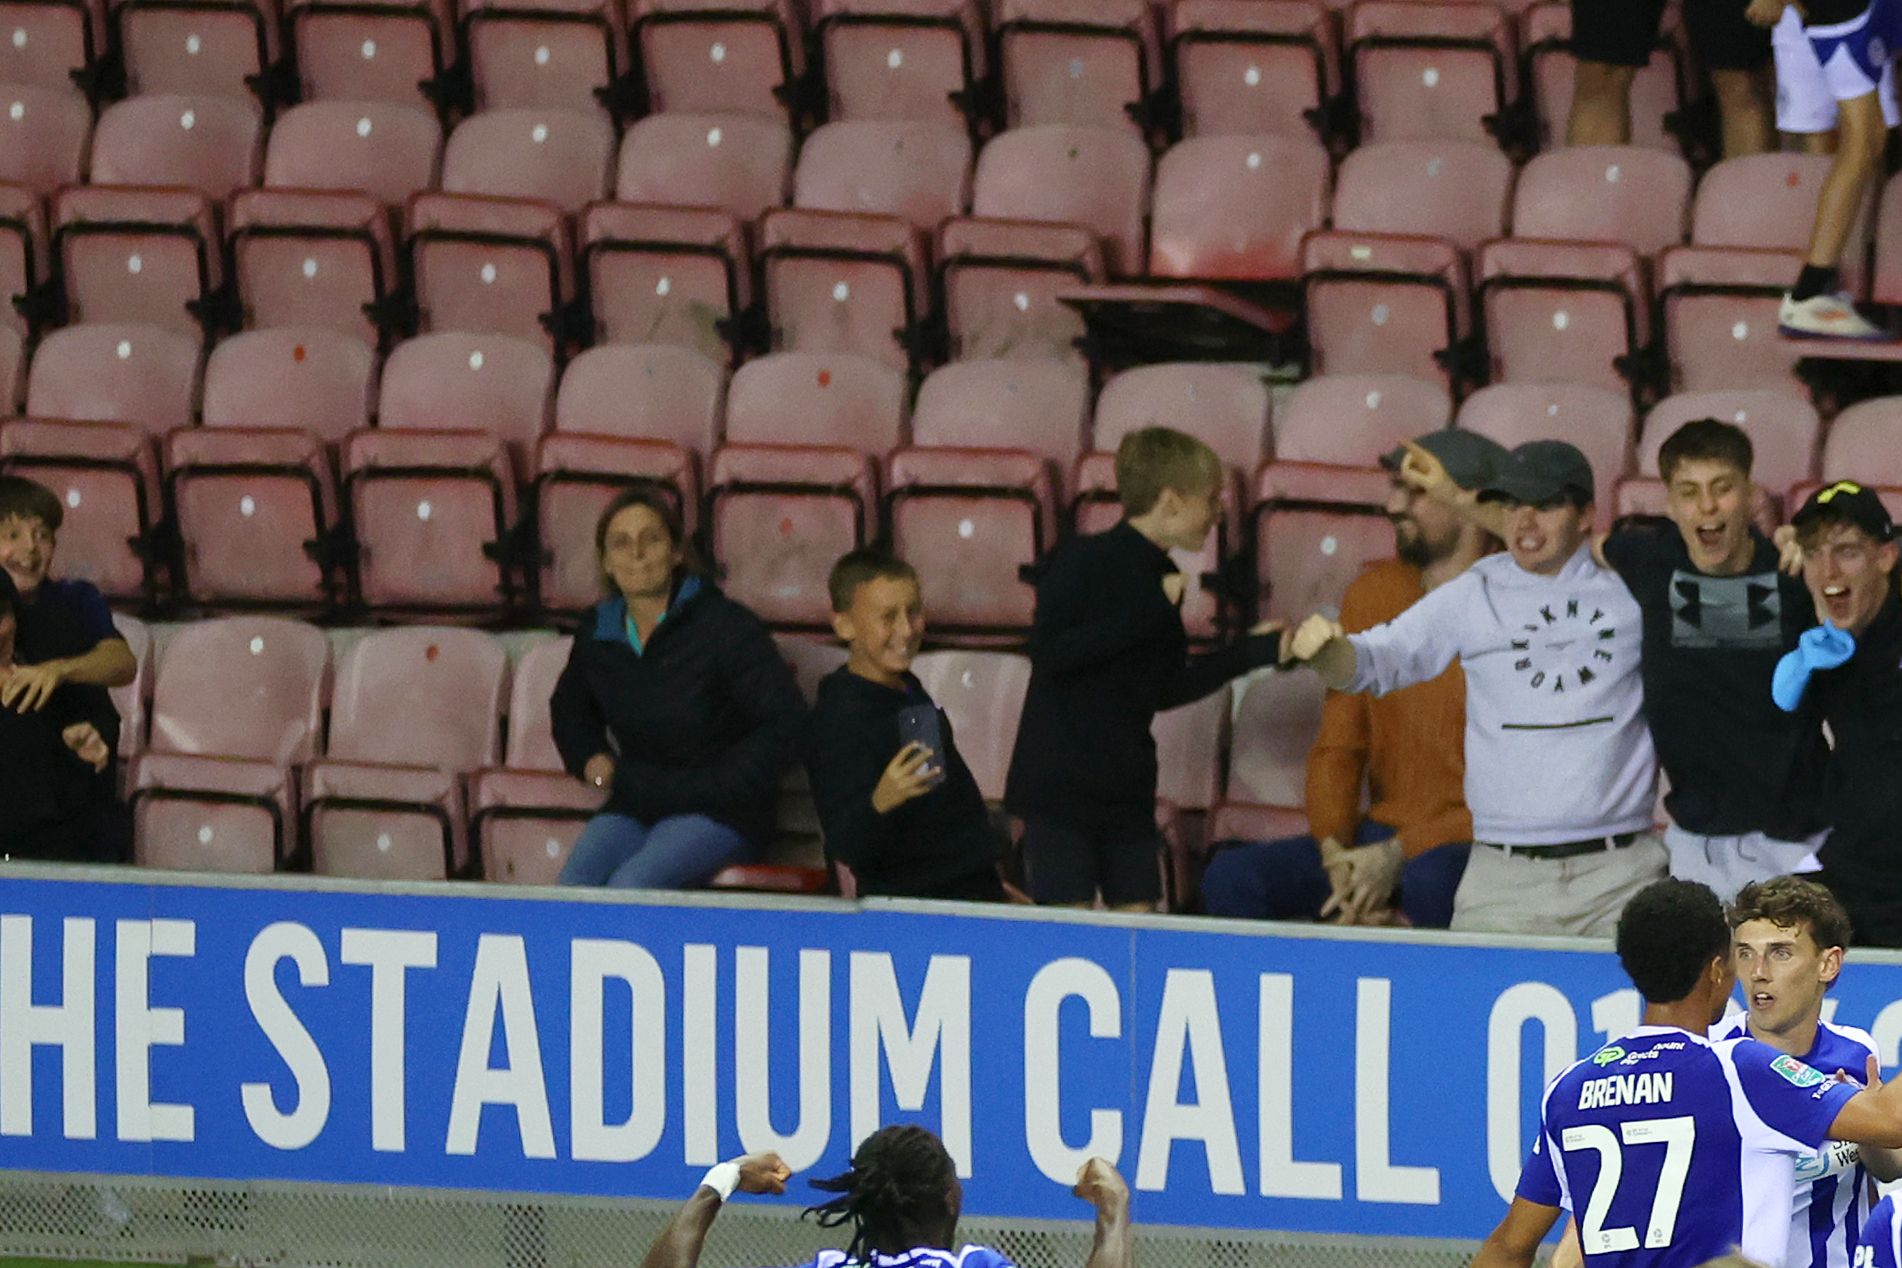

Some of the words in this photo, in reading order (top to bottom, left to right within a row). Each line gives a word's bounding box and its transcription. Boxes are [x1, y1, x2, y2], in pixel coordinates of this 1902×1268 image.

[241, 920, 972, 1180] STADIUM
[1024, 957, 1440, 1205] CALL
[1578, 1072, 1672, 1110] BRENAN
[1561, 1116, 1695, 1255] 27
